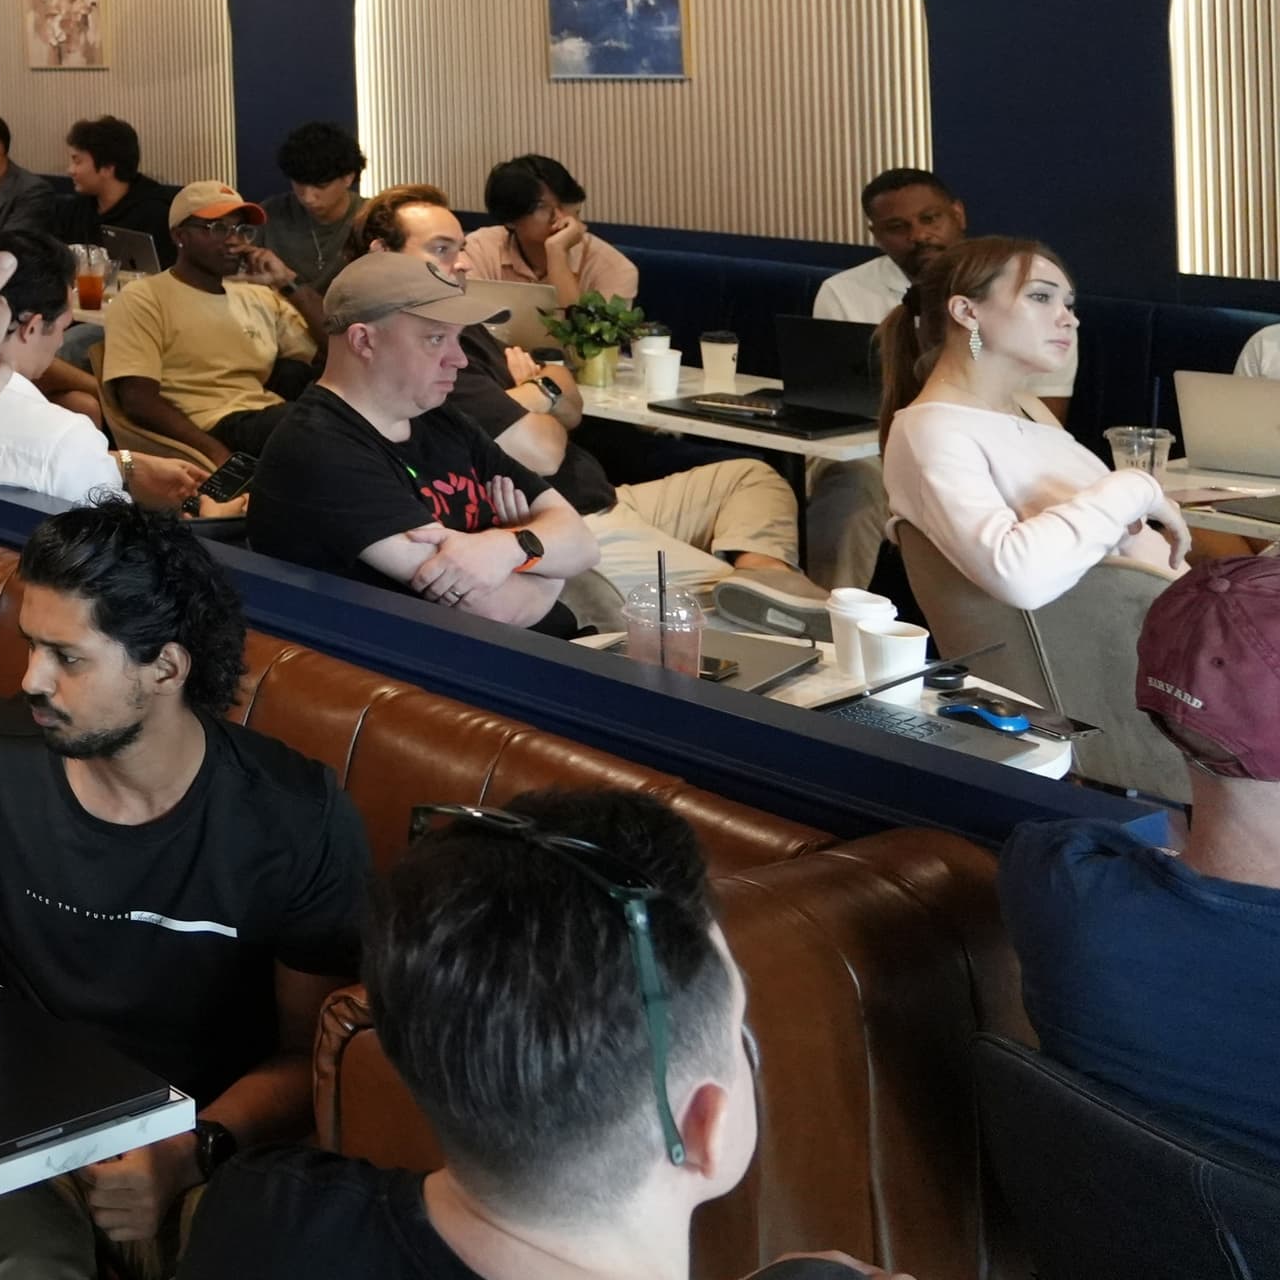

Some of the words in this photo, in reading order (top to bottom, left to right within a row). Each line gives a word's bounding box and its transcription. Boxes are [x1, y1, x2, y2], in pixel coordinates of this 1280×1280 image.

[1147, 676, 1203, 709] HARVARD
[26, 889, 49, 904] FACE
[58, 902, 77, 913] THE
[86, 911, 129, 920] FUTURE
